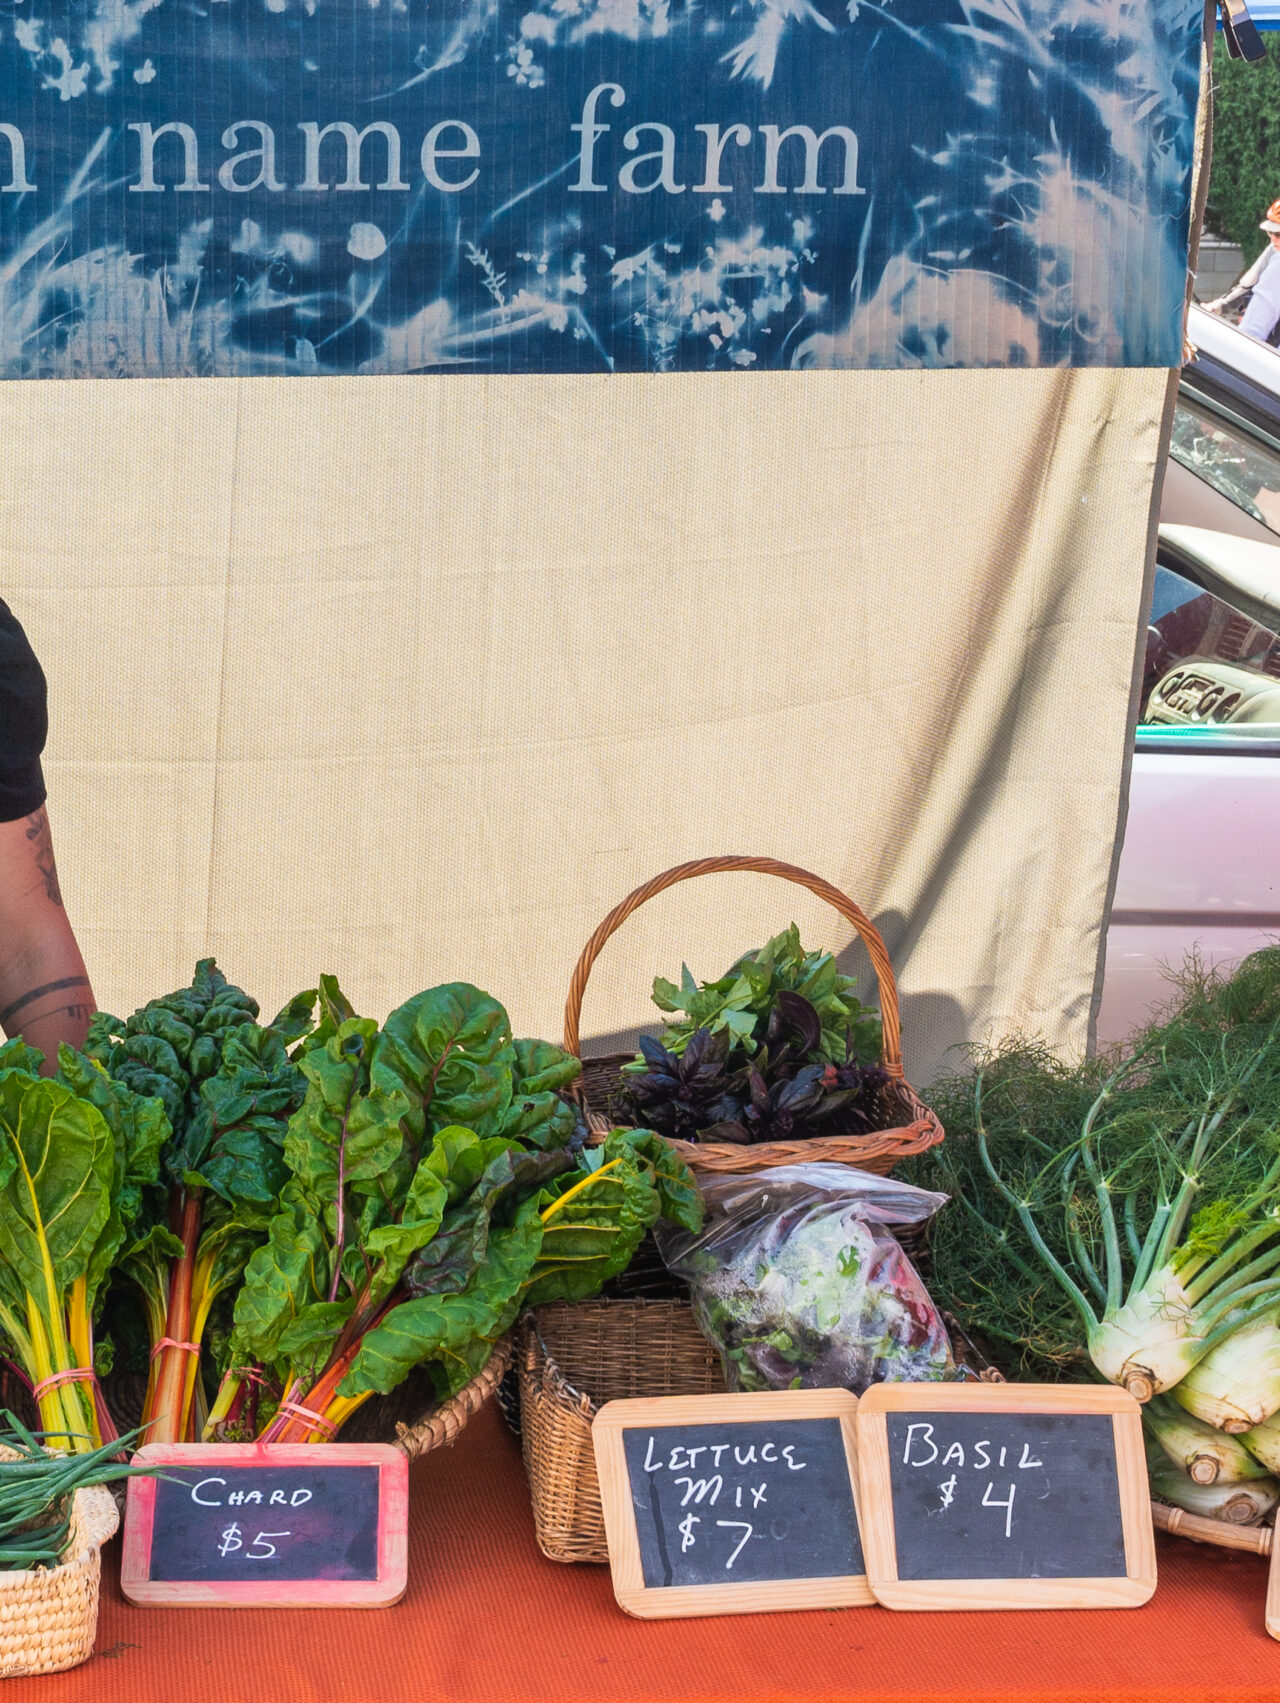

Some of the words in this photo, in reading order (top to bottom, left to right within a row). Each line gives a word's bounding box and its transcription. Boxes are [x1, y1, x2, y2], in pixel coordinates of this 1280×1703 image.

[127, 117, 482, 192] name
[567, 82, 866, 195] farm
[643, 1436, 807, 1472] LETTUCE
[903, 1423, 1043, 1468] BASIL
[191, 1478, 313, 1507] CHARD
[674, 1476, 767, 1508] MIX
[218, 1522, 291, 1559] $5
